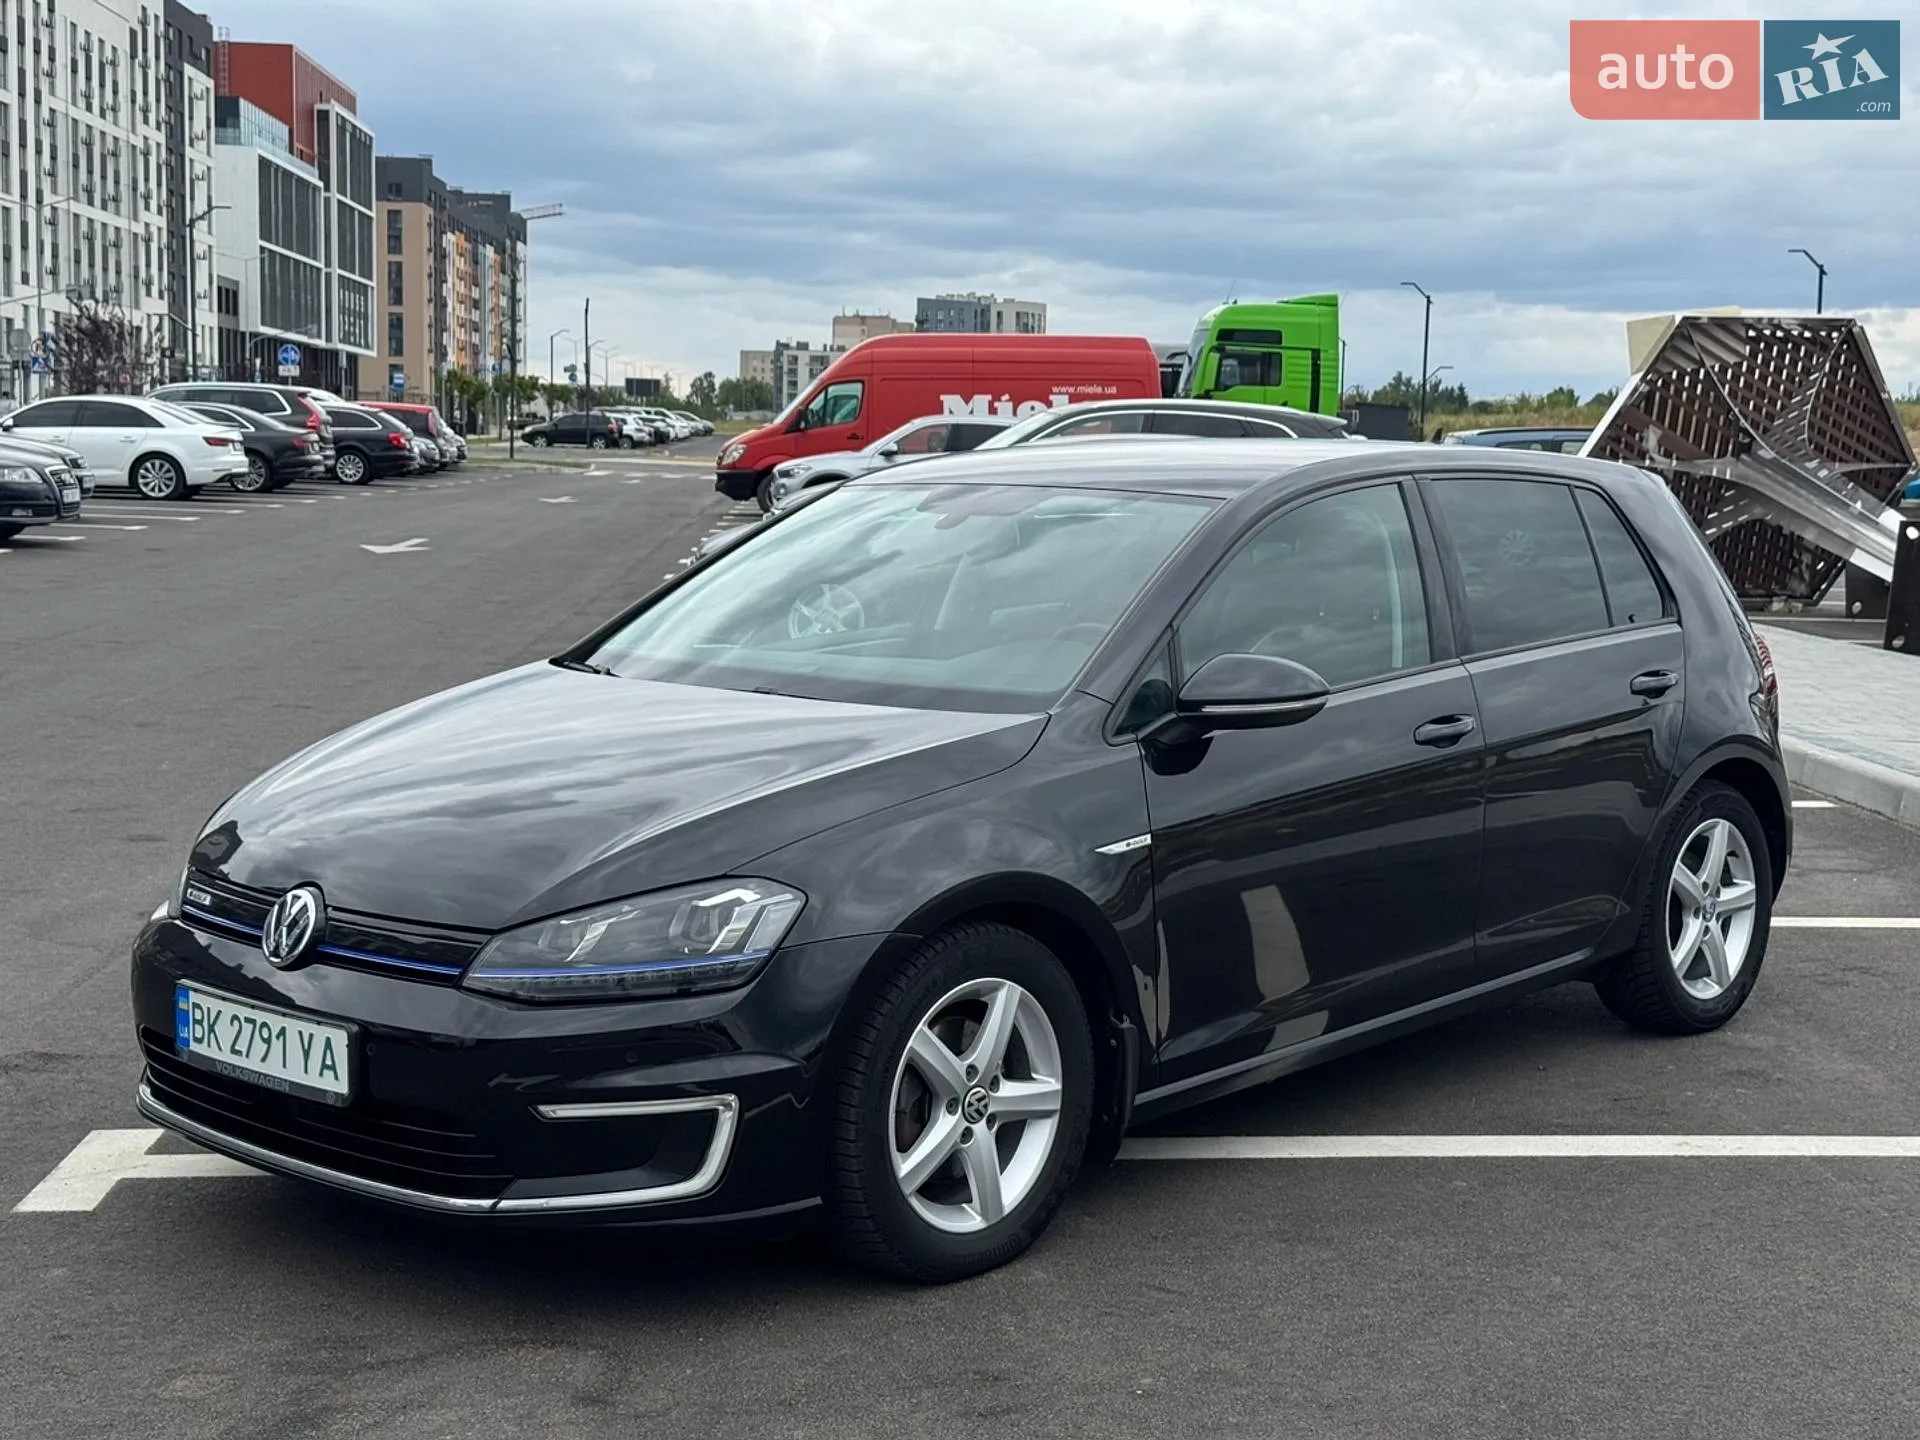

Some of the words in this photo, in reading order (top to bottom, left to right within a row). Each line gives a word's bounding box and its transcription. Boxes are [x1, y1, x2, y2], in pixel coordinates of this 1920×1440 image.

[1051, 384, 1117, 395] www.miele.ua
[939, 393, 1070, 418] Mie
[178, 1025, 189, 1039] UA
[191, 1001, 223, 1053] BK
[229, 1013, 288, 1070] 2791
[297, 1029, 340, 1082] YA
[215, 1061, 290, 1093] VOLKSWAGEN
